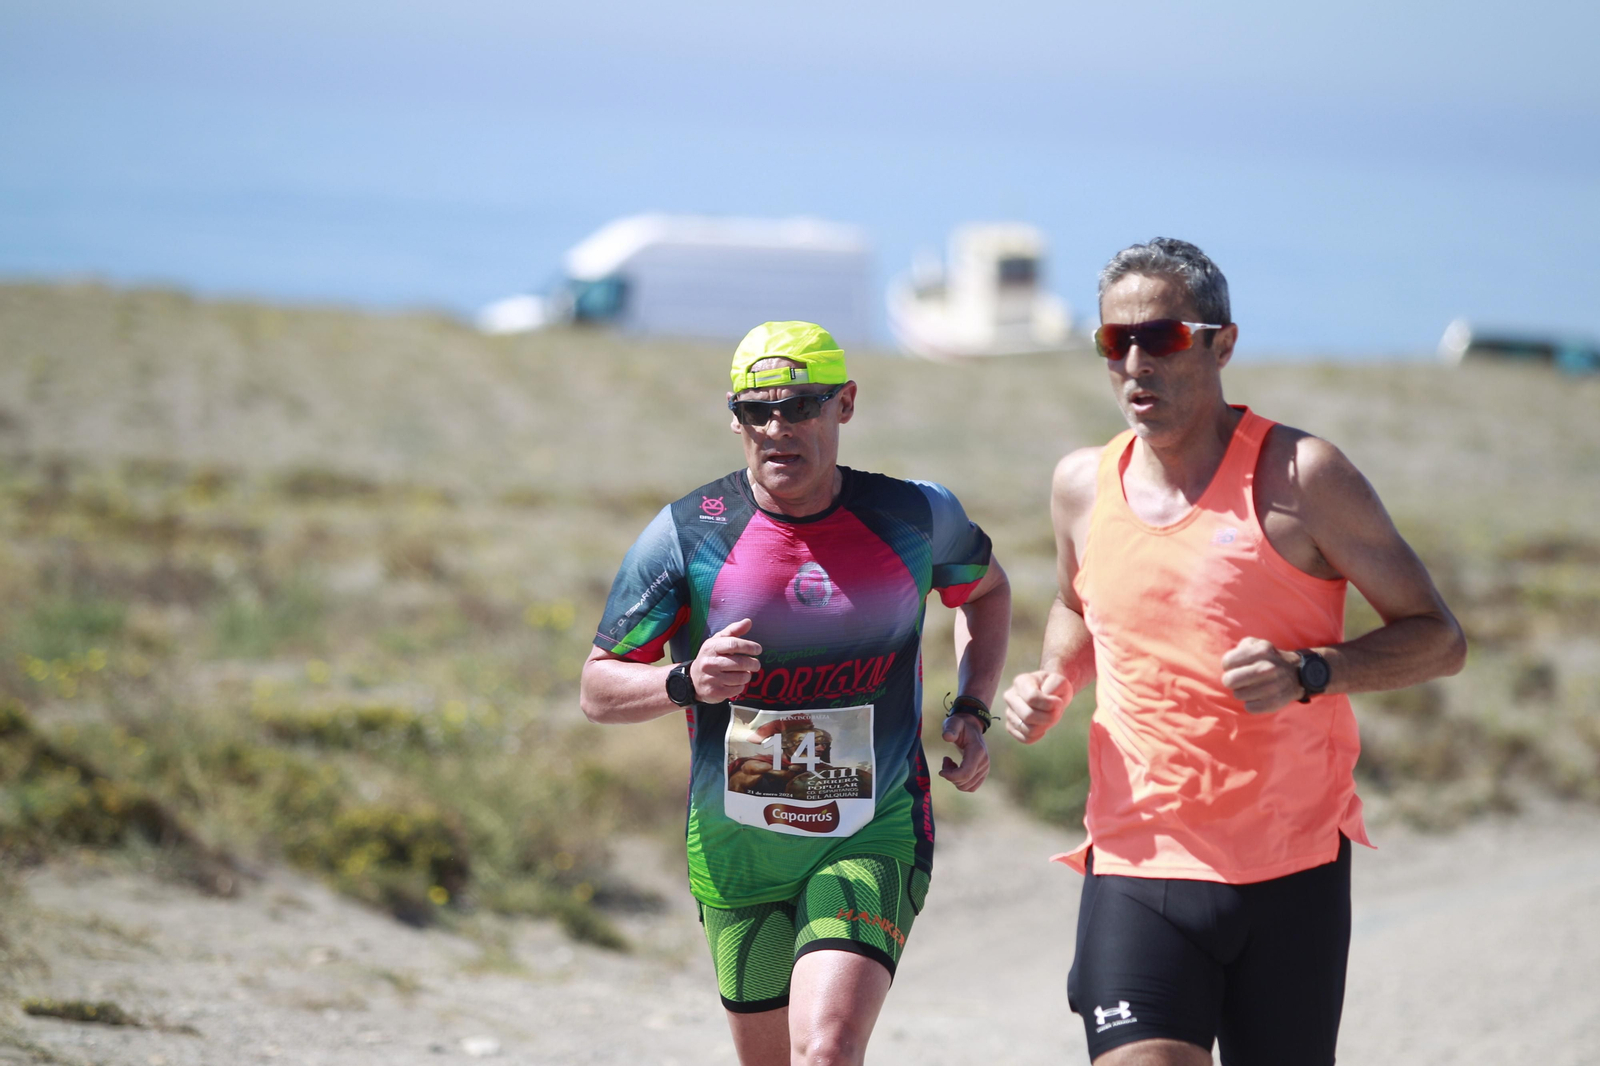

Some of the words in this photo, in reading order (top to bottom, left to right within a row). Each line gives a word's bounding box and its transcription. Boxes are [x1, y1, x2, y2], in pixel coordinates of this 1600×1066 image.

[729, 651, 896, 704] PORTGYM
[763, 731, 820, 772] 14
[807, 766, 859, 780] XIII
[807, 776, 860, 786] CARRERA
[807, 782, 859, 791] POPULAR
[818, 787, 859, 795] ESPARTANOS
